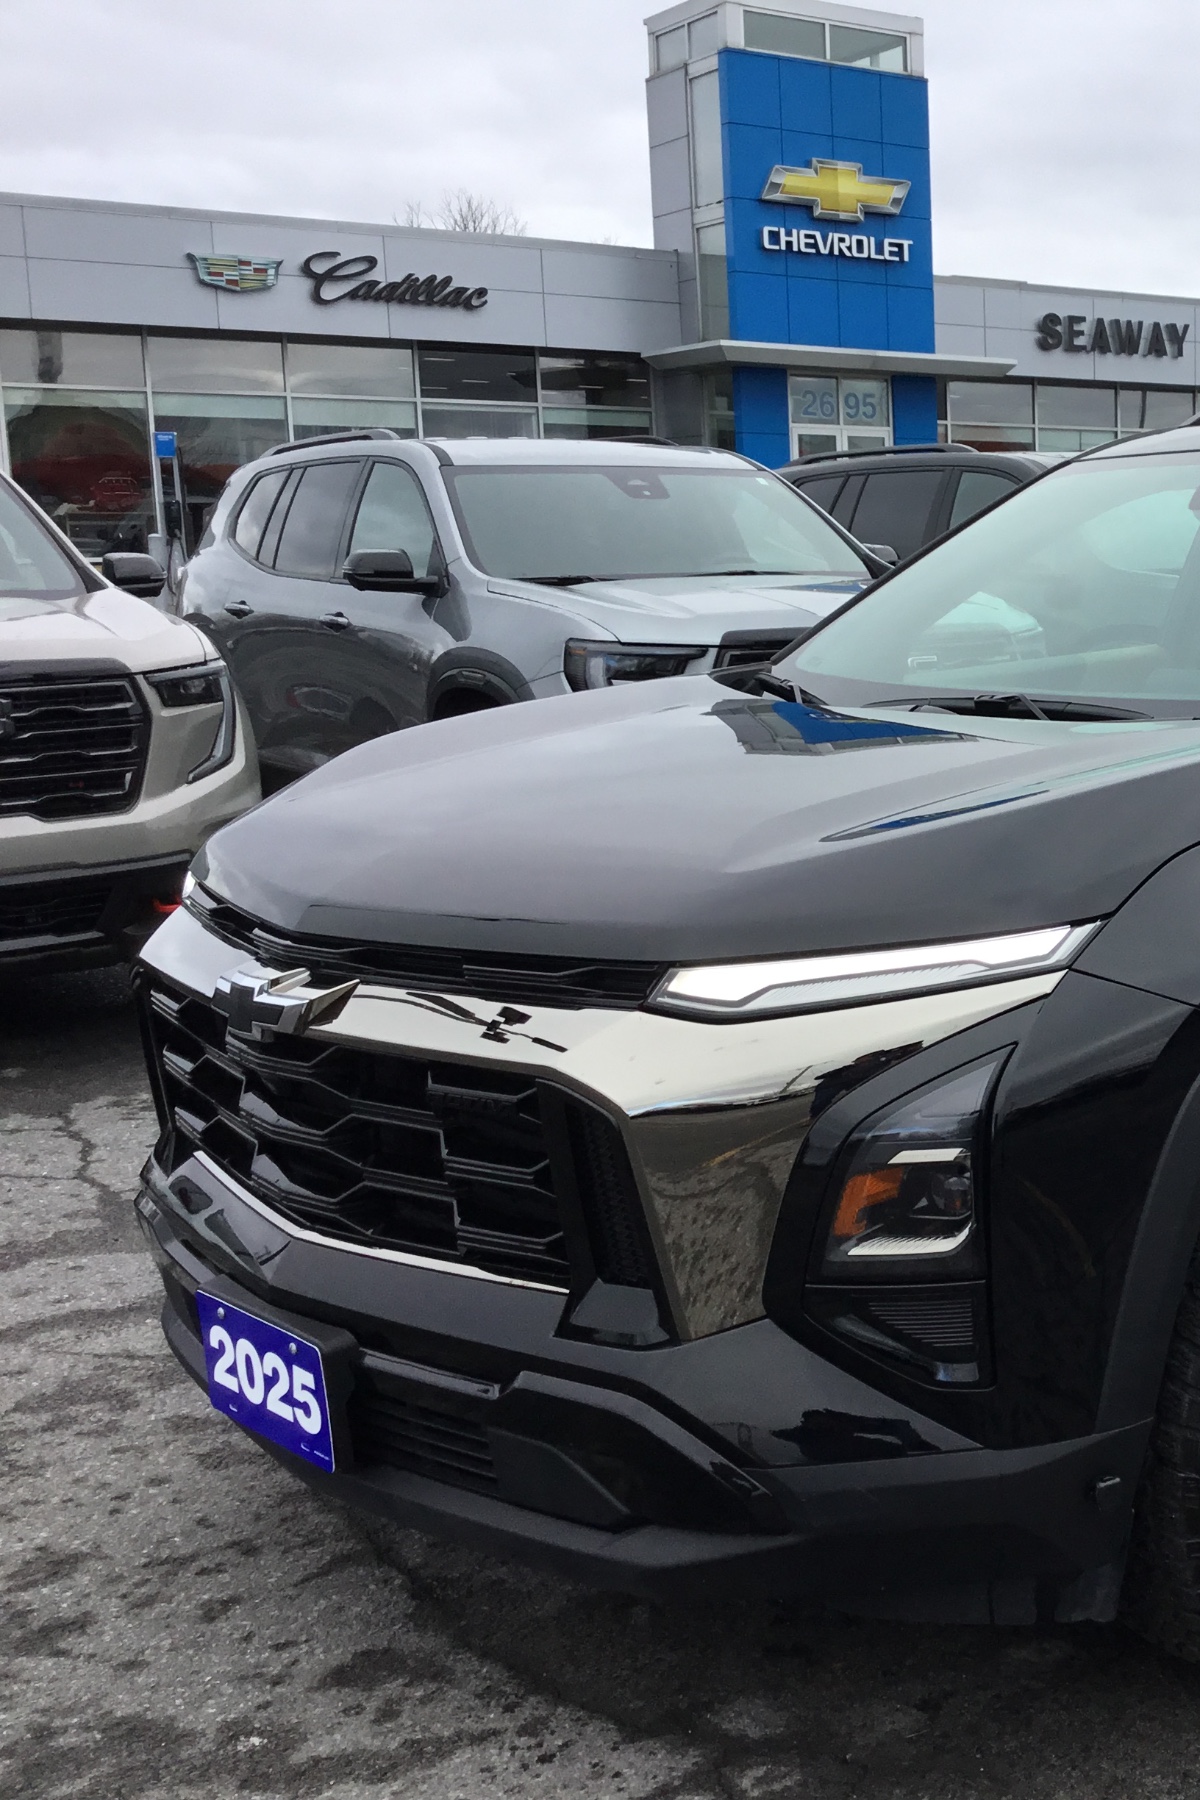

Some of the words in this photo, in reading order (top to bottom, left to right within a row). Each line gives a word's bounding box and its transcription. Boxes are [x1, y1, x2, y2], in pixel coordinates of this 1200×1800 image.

[762, 226, 914, 262] CHEVROLET
[303, 251, 489, 311] Cadillac
[1037, 312, 1190, 358] SEAWAY
[209, 1324, 323, 1436] 2025
